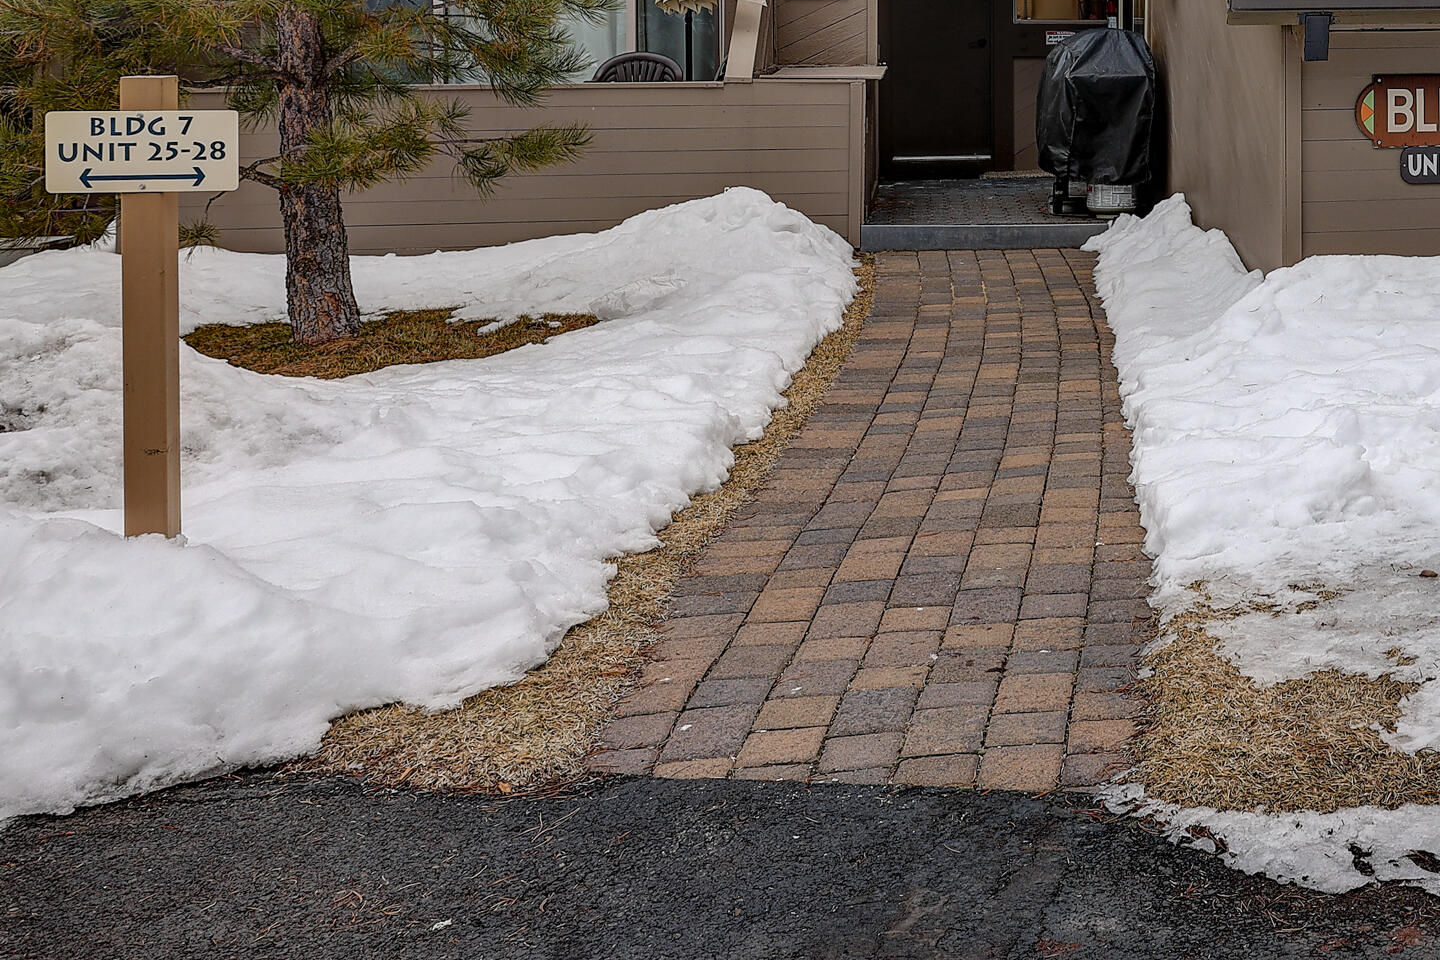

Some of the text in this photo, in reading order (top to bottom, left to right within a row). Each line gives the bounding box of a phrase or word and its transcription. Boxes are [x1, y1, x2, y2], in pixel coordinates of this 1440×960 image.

[90, 116, 194, 137] BLDG 7
[58, 140, 226, 163] UNIT 25-28
